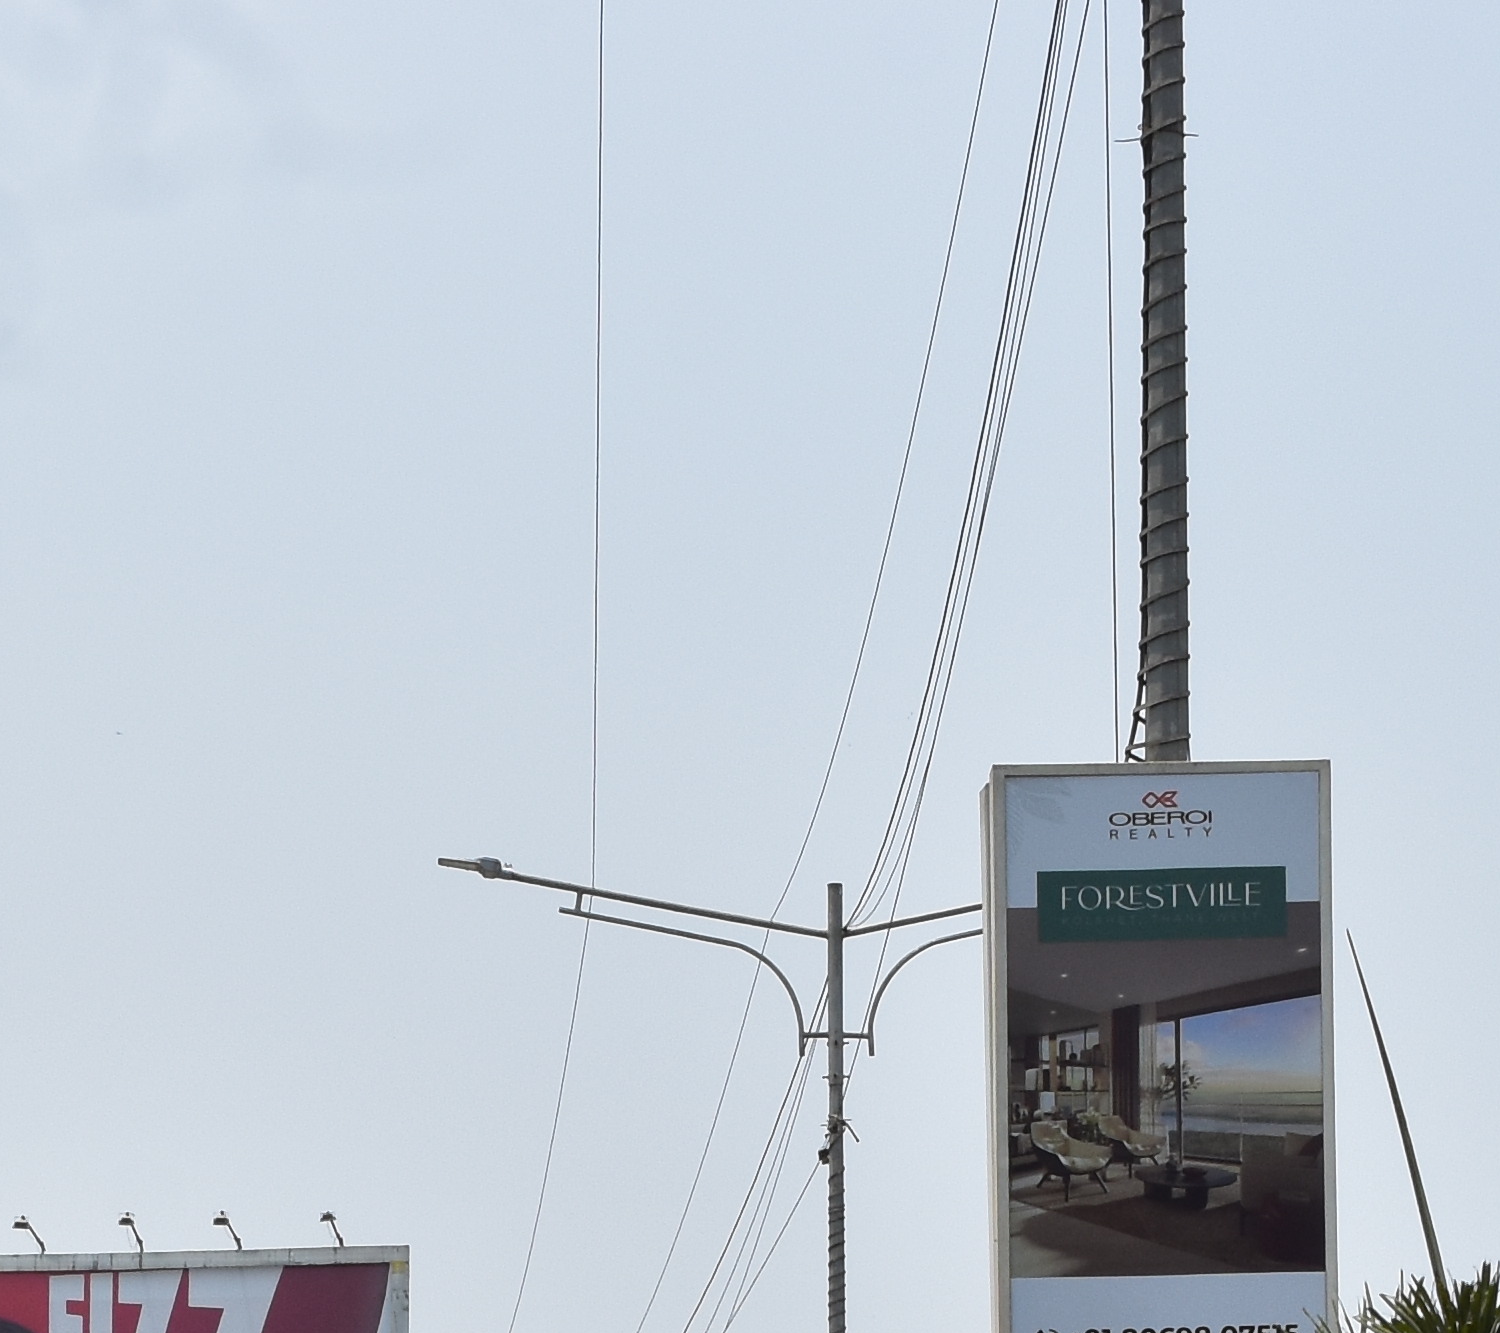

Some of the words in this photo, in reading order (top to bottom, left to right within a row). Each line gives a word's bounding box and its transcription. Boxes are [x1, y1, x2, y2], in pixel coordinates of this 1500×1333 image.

[1109, 810, 1212, 826] OBEROI
[1109, 827, 1212, 840] REALTY
[1061, 882, 1261, 911] FORESTVILLE
